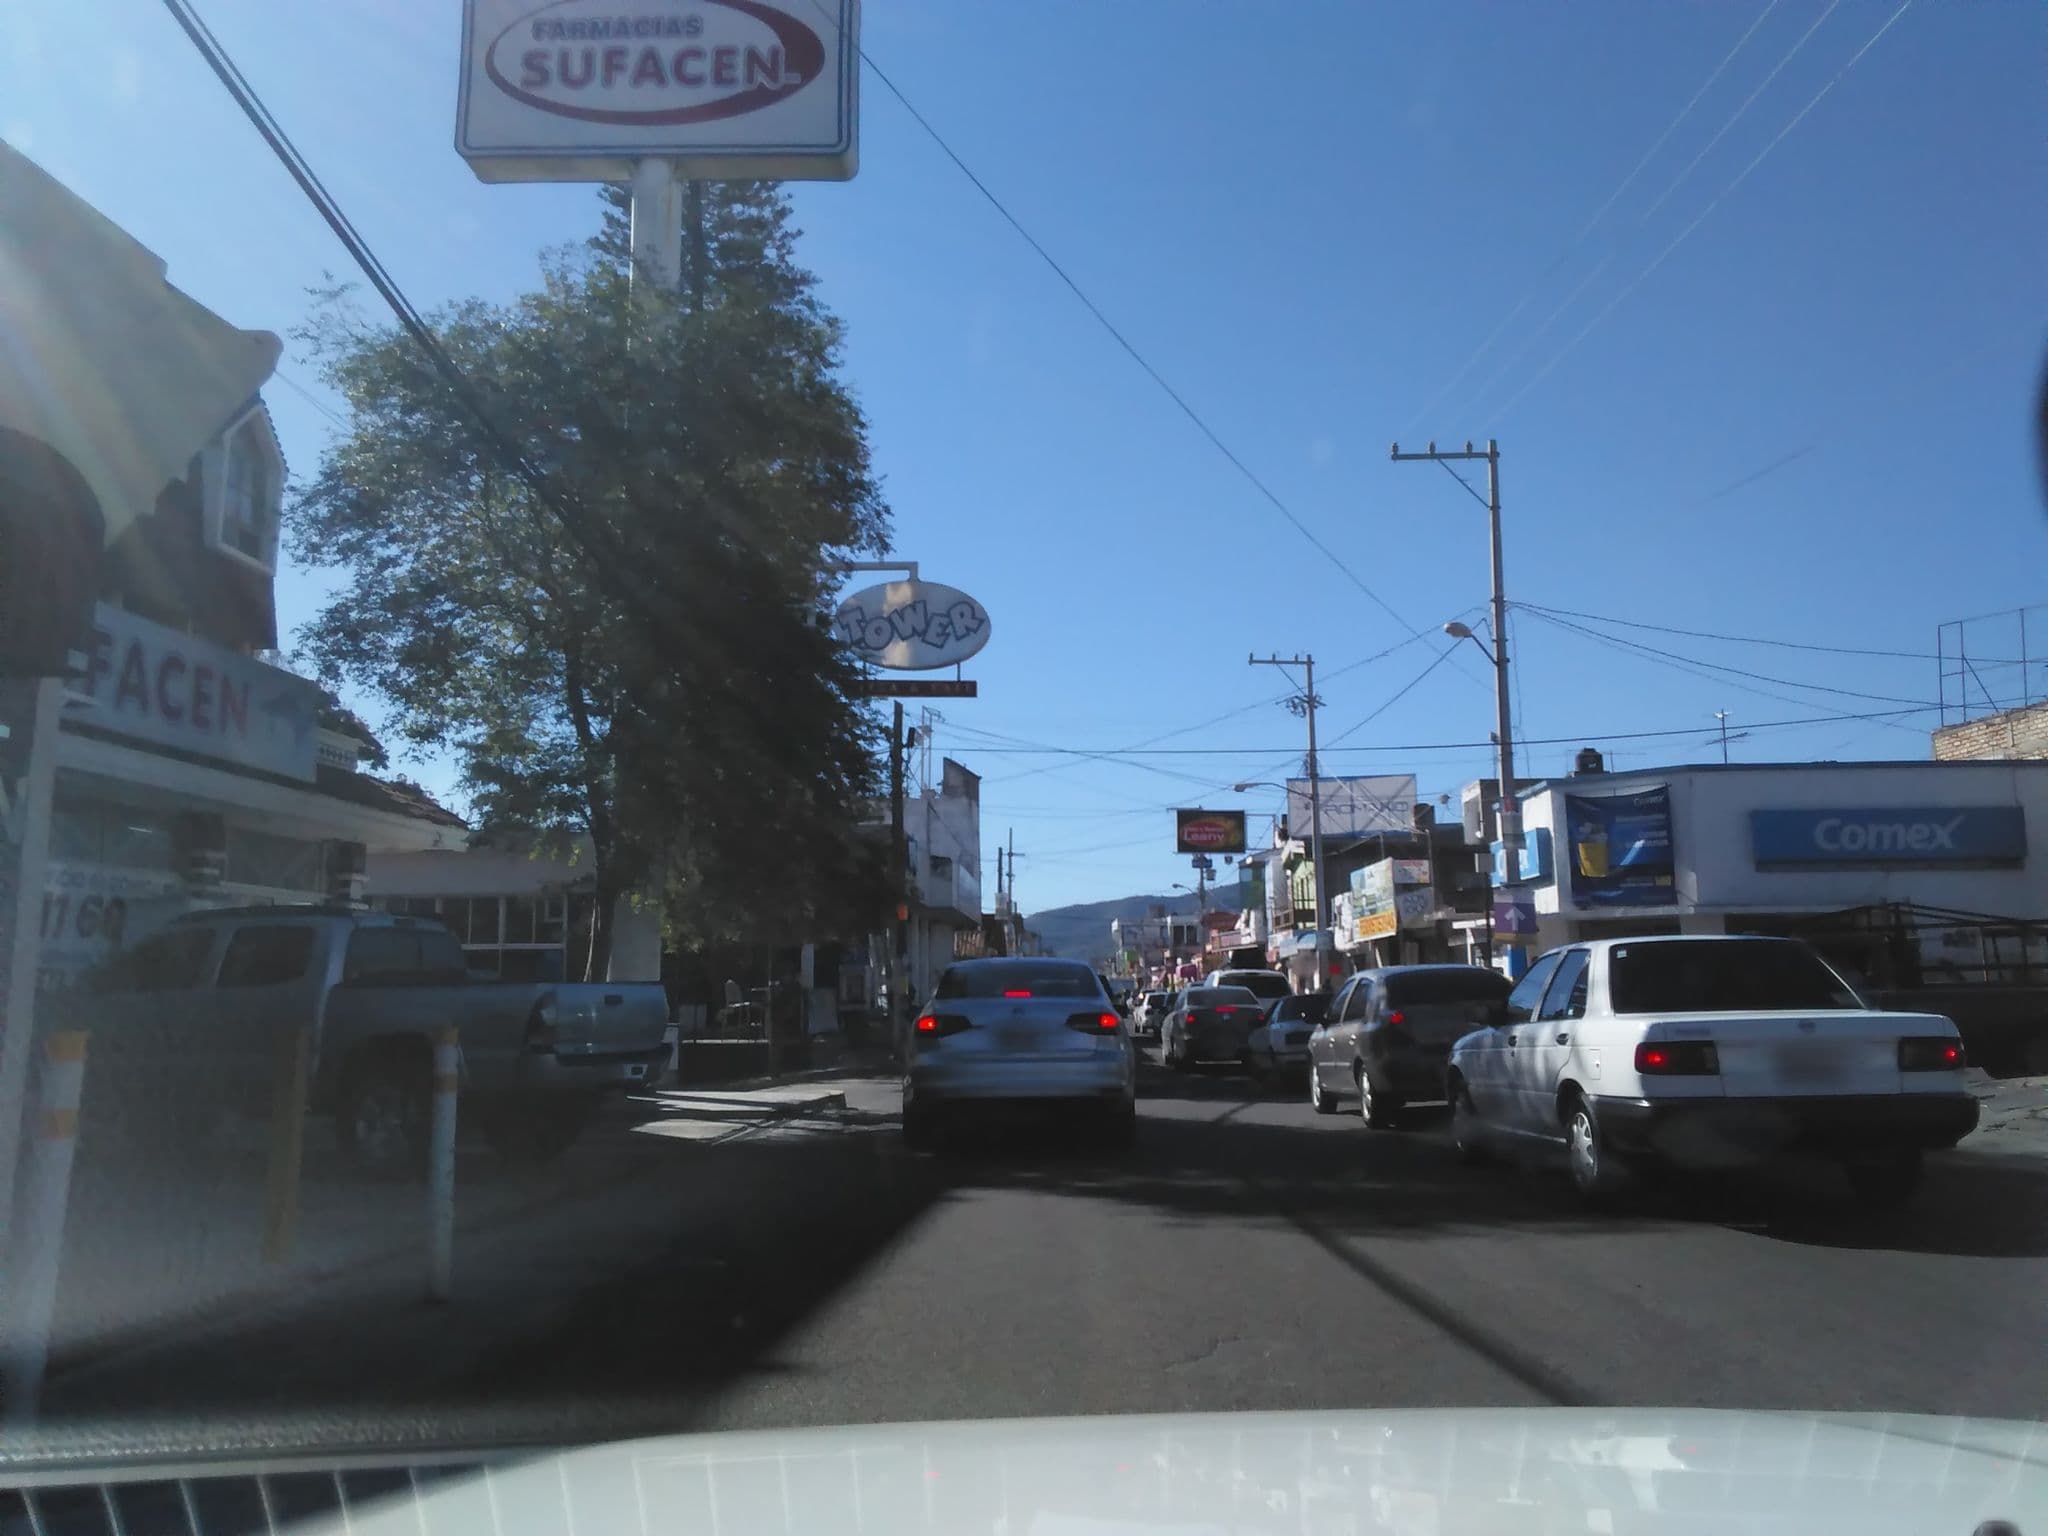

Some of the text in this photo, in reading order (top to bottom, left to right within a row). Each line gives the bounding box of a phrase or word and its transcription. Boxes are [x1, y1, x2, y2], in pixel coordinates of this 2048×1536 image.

[532, 15, 705, 41] FARMACIAS
[520, 46, 783, 91] SUFACEN
[837, 600, 986, 651] TOWER
[1815, 815, 1966, 850] Comex
